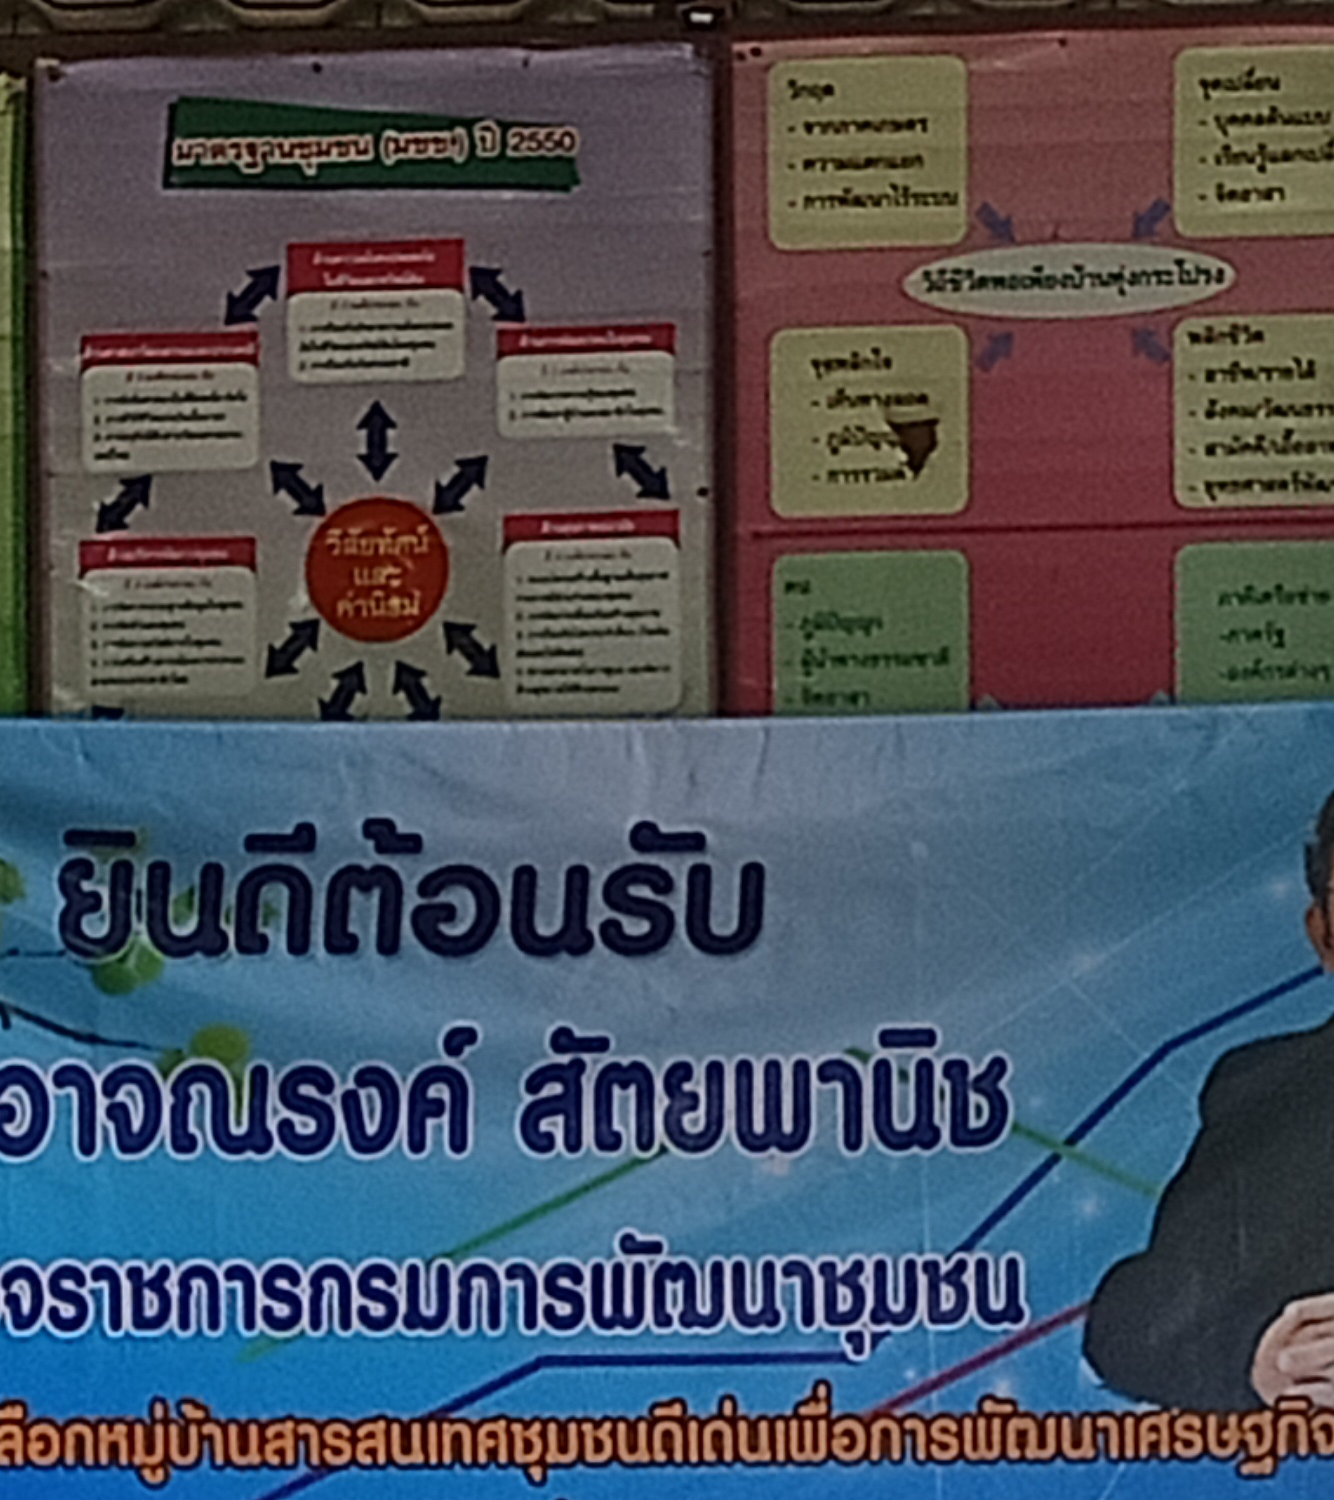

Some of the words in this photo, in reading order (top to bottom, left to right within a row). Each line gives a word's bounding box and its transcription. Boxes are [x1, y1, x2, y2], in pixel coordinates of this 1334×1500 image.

[507, 127, 578, 156] 2550
[57, 817, 768, 960] ยินดีต้อนรับ
[518, 1024, 1014, 1160] สัตยพานิช
